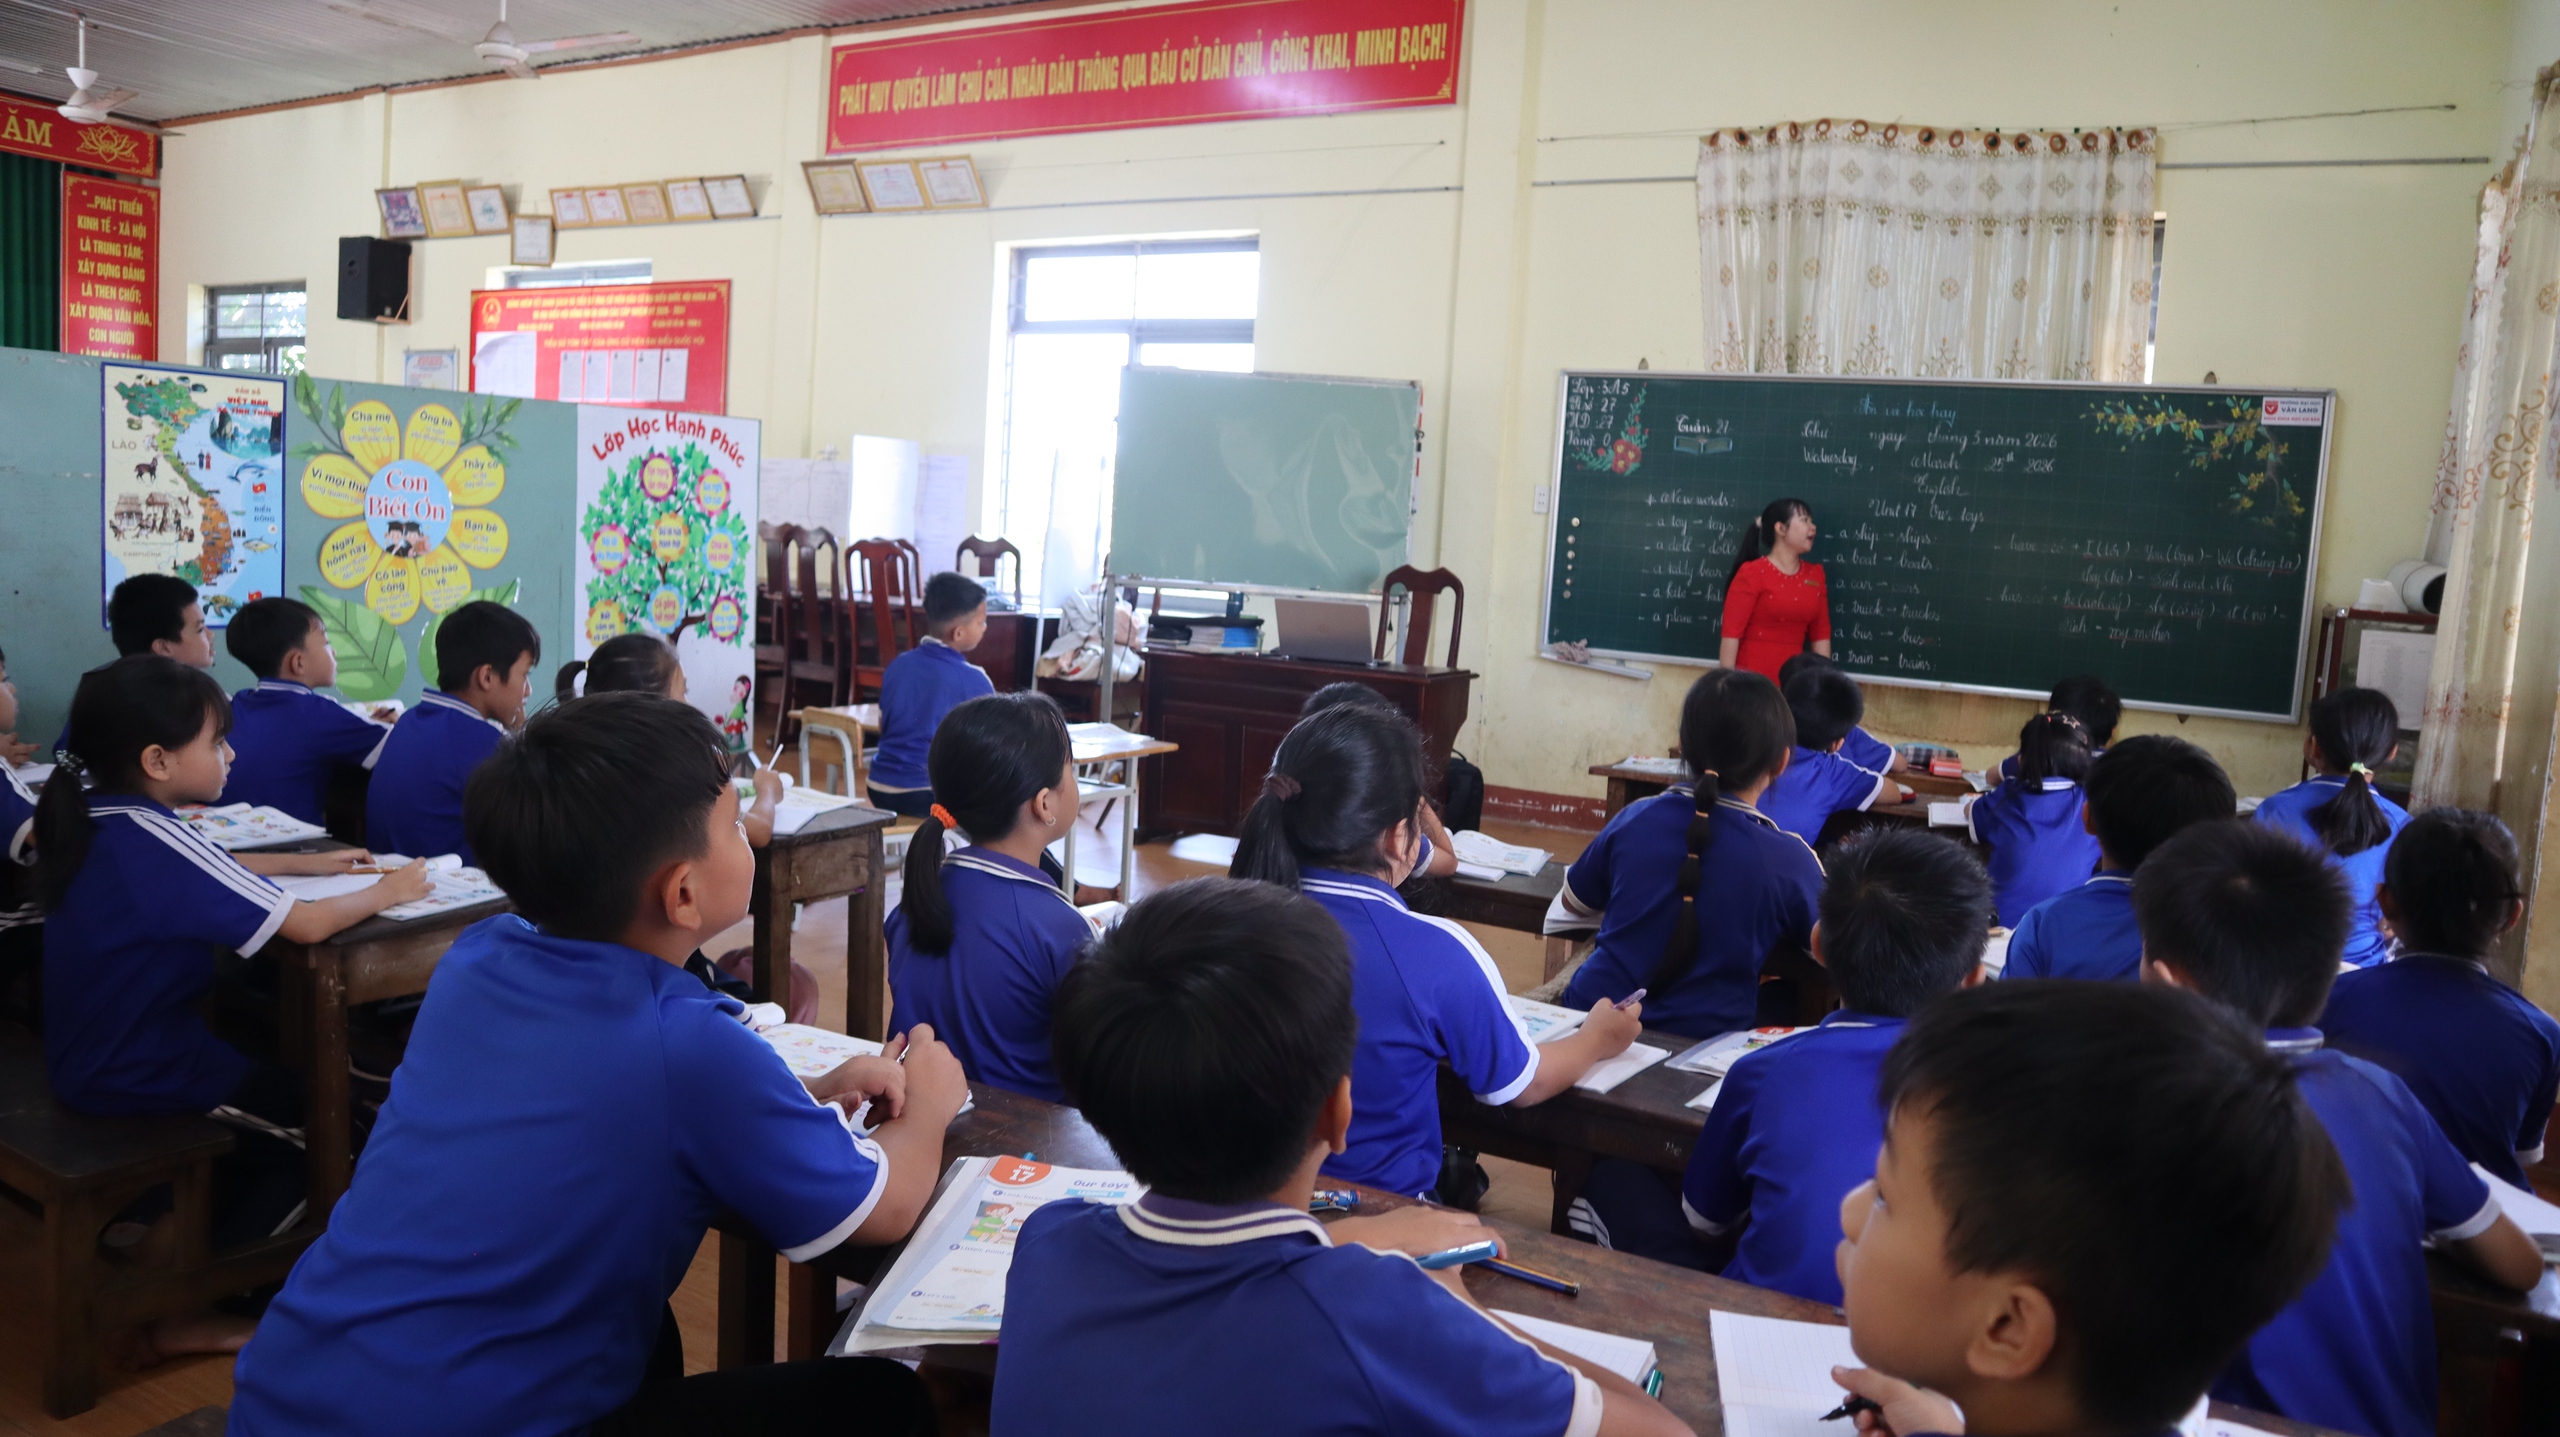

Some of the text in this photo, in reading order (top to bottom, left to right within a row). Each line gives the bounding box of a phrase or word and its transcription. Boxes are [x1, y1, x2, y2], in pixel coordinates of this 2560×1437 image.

[839, 77, 868, 117] PHÁT
[868, 80, 891, 113] HUY
[930, 67, 957, 107] LÀM
[958, 59, 983, 104] CHỦ
[984, 57, 1009, 102] CỦA
[1011, 57, 1046, 99] NHÂN
[1048, 54, 1075, 95] DÂN
[1077, 50, 1120, 92] THÔNG
[1121, 53, 1147, 93] QUA
[1201, 37, 1232, 81] DÂN
[1270, 30, 1310, 75] CÔNG
[1312, 32, 1350, 73] KHAI,
[1355, 27, 1397, 67] MINH
[1399, 23, 1447, 71] BẠCH!
[0, 107, 53, 148] ĂM
[77, 215, 99, 231] KINH
[100, 215, 111, 233] TẾ
[132, 225, 147, 242] HỘI
[79, 235, 91, 252] LÀ
[93, 240, 121, 257] TRUNG
[77, 258, 95, 275] XÂY
[97, 261, 121, 281] DỰNG
[81, 280, 93, 297] LÀ
[94, 286, 116, 303] THEN
[69, 301, 87, 318] XÂY
[89, 305, 113, 324] DỰNG
[114, 307, 132, 324] VĂN
[88, 327, 135, 346] CON NGƯỜI
[227, 396, 269, 406] VIỆT NAM
[1600, 397, 1617, 413] 27
[351, 410, 373, 422] Cha
[1676, 414, 1712, 434] Tuần
[111, 437, 137, 450] LÀO
[592, 411, 745, 468] Lớp Học Hạnh Phúc
[1972, 430, 1981, 445] 3
[2024, 431, 2058, 448] 2026
[1911, 452, 1960, 470] March
[325, 473, 347, 489] mọi
[386, 469, 429, 493] Con
[367, 495, 446, 521] Biết Ơn
[1868, 500, 1901, 518] Unit
[1904, 502, 1918, 518] 17
[1960, 507, 1985, 532] toys
[464, 518, 484, 532] Bạn
[1657, 517, 1666, 527] a
[1671, 515, 1688, 535] toy
[1656, 542, 1664, 550] a
[1668, 536, 1693, 553] doll
[1839, 529, 1848, 539] a
[1854, 522, 1880, 549] ship
[1836, 554, 1846, 563] a
[1852, 548, 1878, 565] boat
[391, 568, 407, 577] lao
[1836, 579, 1845, 588] a
[1653, 588, 1660, 598] a
[1836, 603, 1845, 614] a
[1851, 598, 1885, 616] truck
[1653, 612, 1661, 622] a
[1834, 623, 1874, 641] a bus
[1832, 651, 1840, 662] a
[1848, 650, 1874, 665] train
[1008, 1168, 1037, 1183] 17
[1018, 1163, 1037, 1172] UNIT
[1073, 1179, 1131, 1190] Our toys
